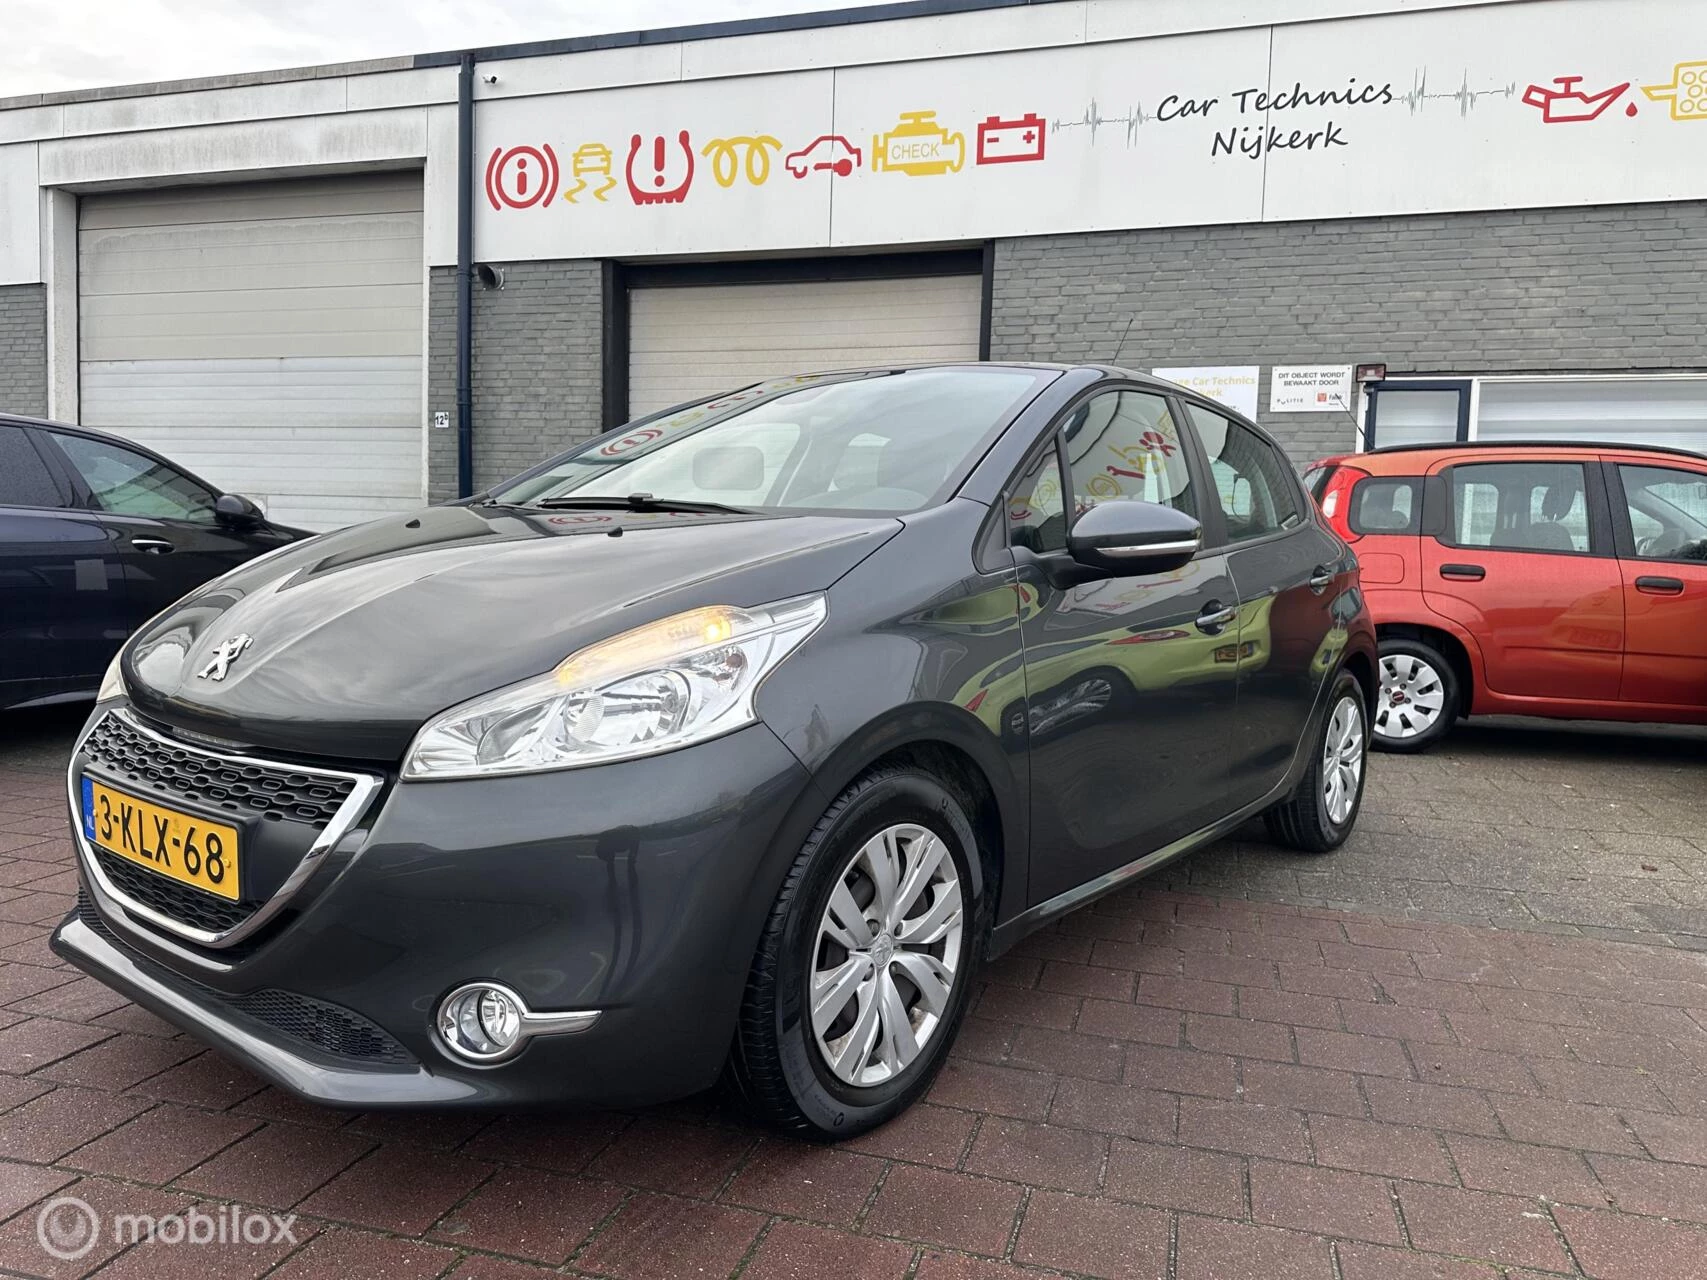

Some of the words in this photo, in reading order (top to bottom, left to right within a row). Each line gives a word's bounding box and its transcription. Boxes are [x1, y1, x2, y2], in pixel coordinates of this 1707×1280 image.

[1156, 95, 1219, 122] Car
[1231, 78, 1393, 114] Technics
[891, 143, 940, 160] CHECK
[1211, 121, 1349, 160] Nijkerk
[1192, 377, 1209, 385] Car
[1212, 375, 1256, 385] Technics
[100, 794, 225, 884] 3-KLX-68
